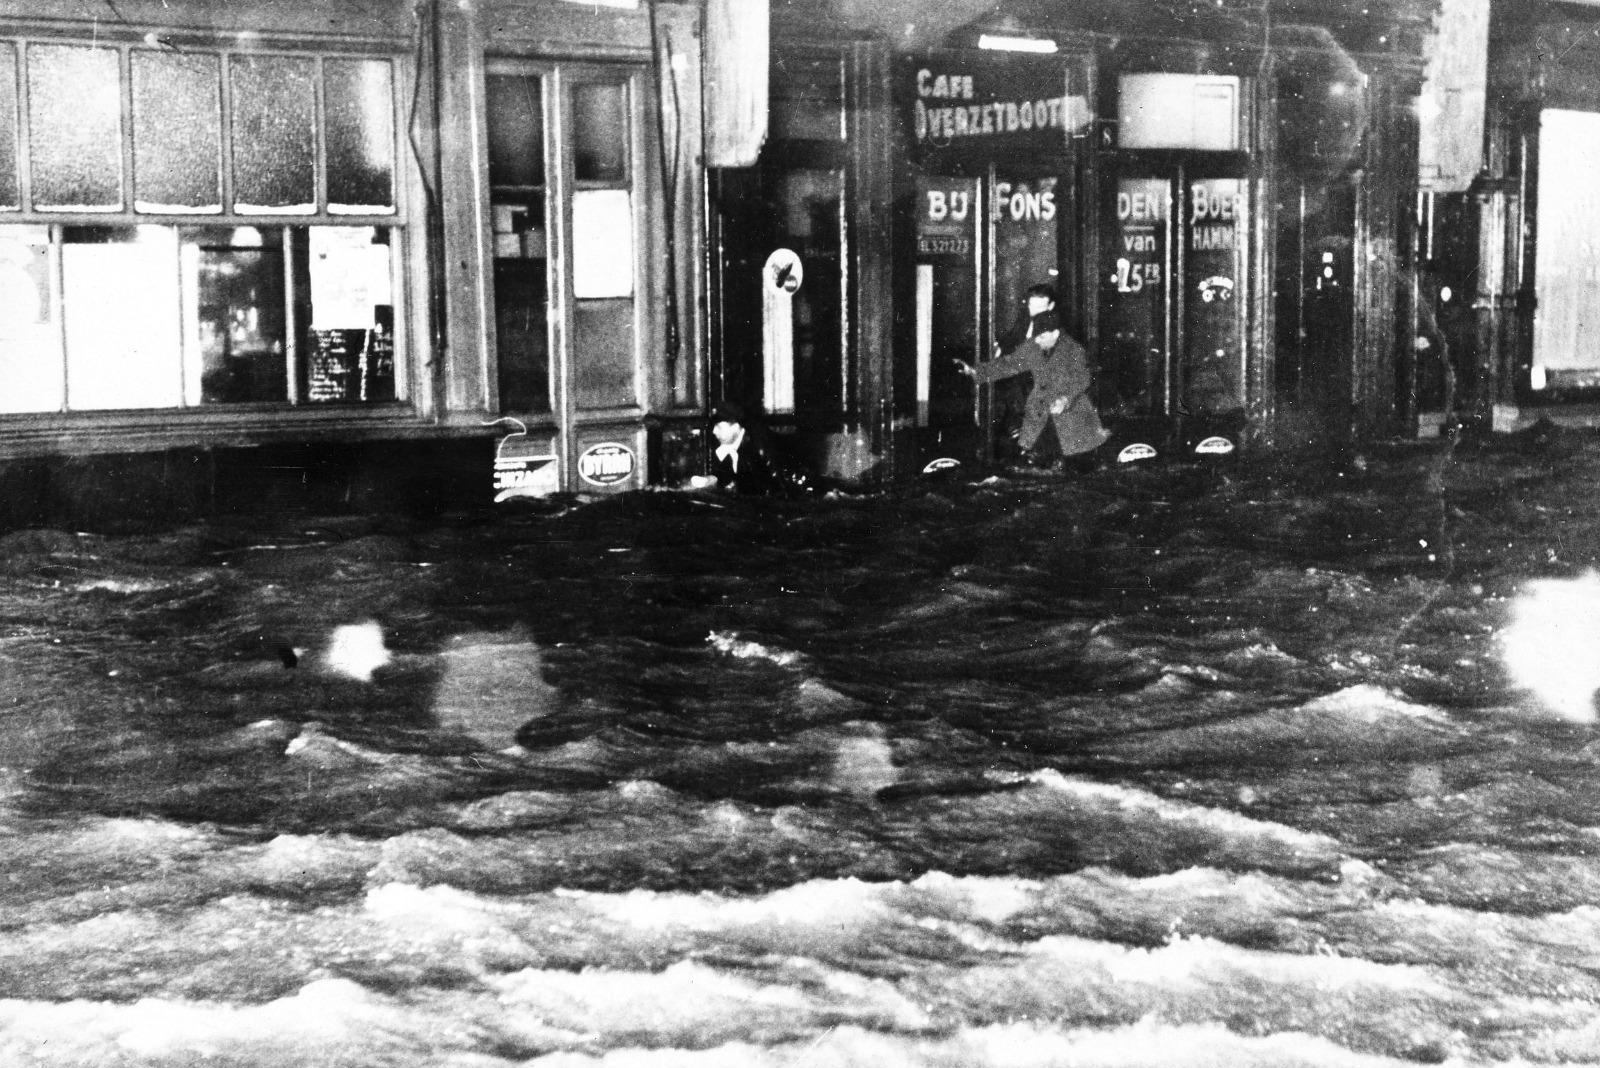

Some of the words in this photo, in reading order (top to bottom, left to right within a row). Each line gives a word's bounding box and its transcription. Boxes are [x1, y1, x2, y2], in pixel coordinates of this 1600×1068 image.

[917, 68, 973, 98] CAFE
[994, 182, 1056, 221] FONS
[1117, 192, 1159, 220] DEN
[1124, 235, 1156, 251] van
